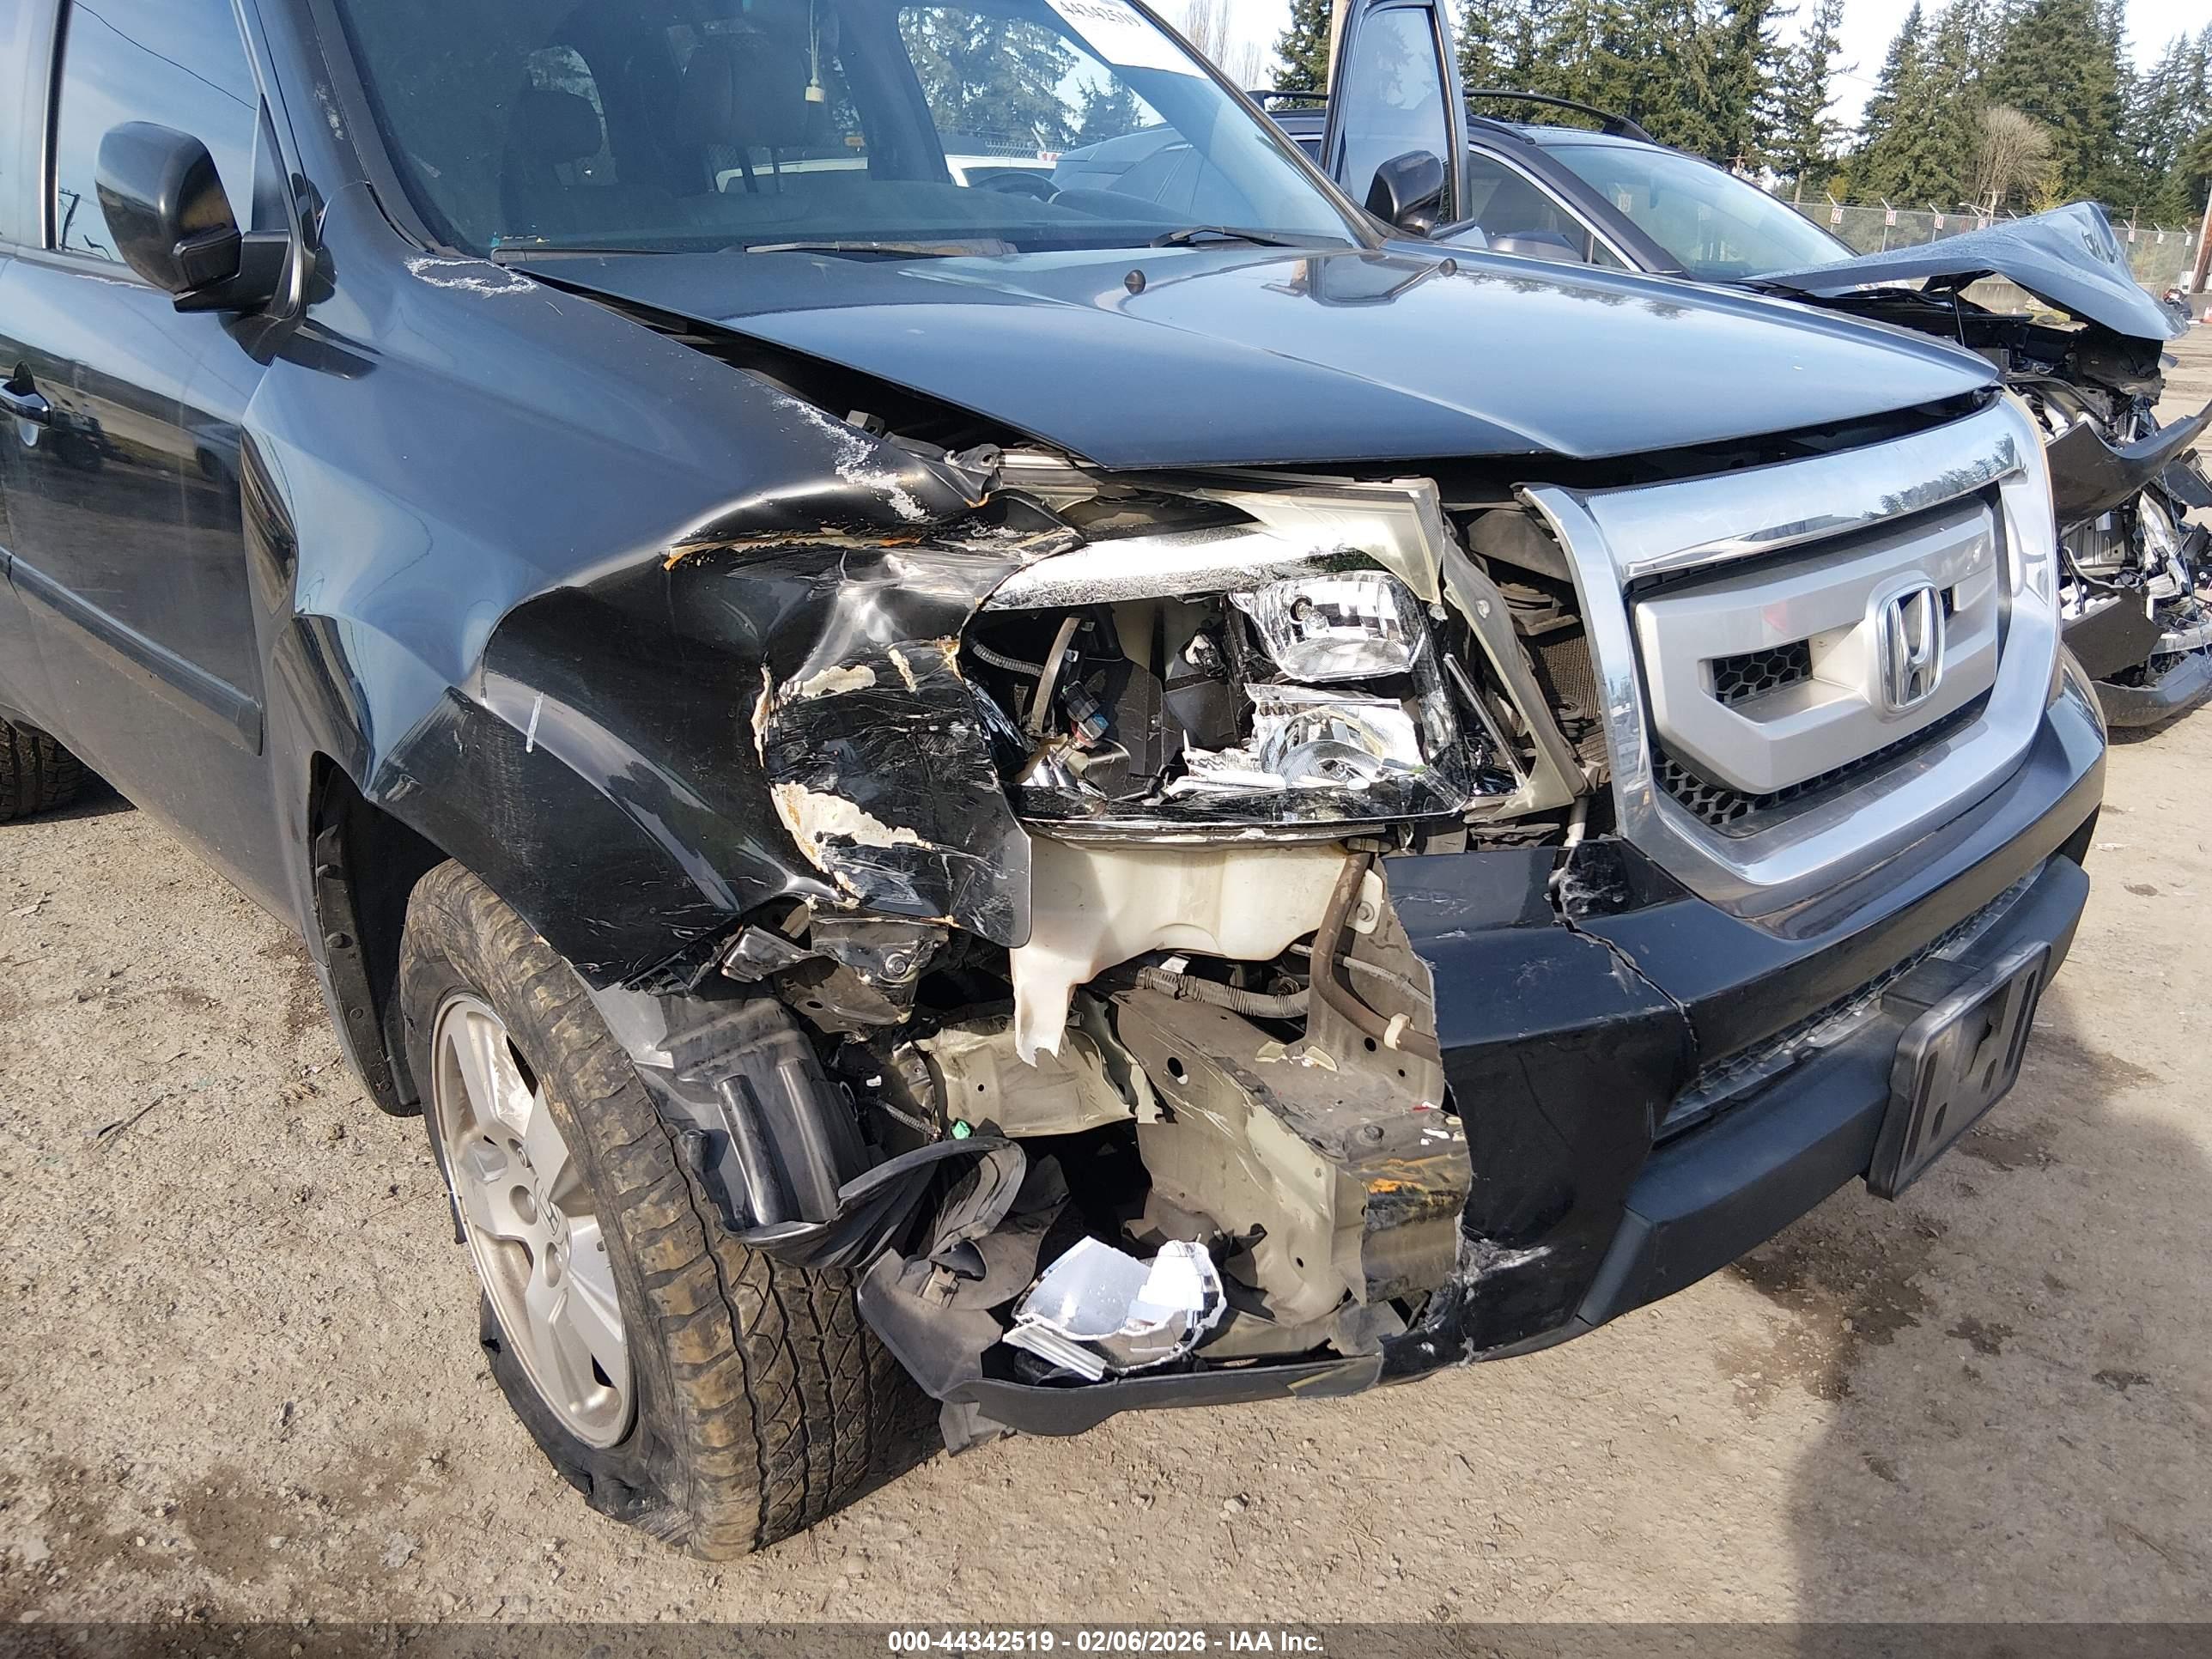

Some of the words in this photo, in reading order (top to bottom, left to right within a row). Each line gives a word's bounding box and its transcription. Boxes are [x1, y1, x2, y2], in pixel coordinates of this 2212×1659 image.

[1832, 209, 1841, 222] 22
[1887, 211, 1895, 225] 23
[1936, 215, 1943, 228] 24
